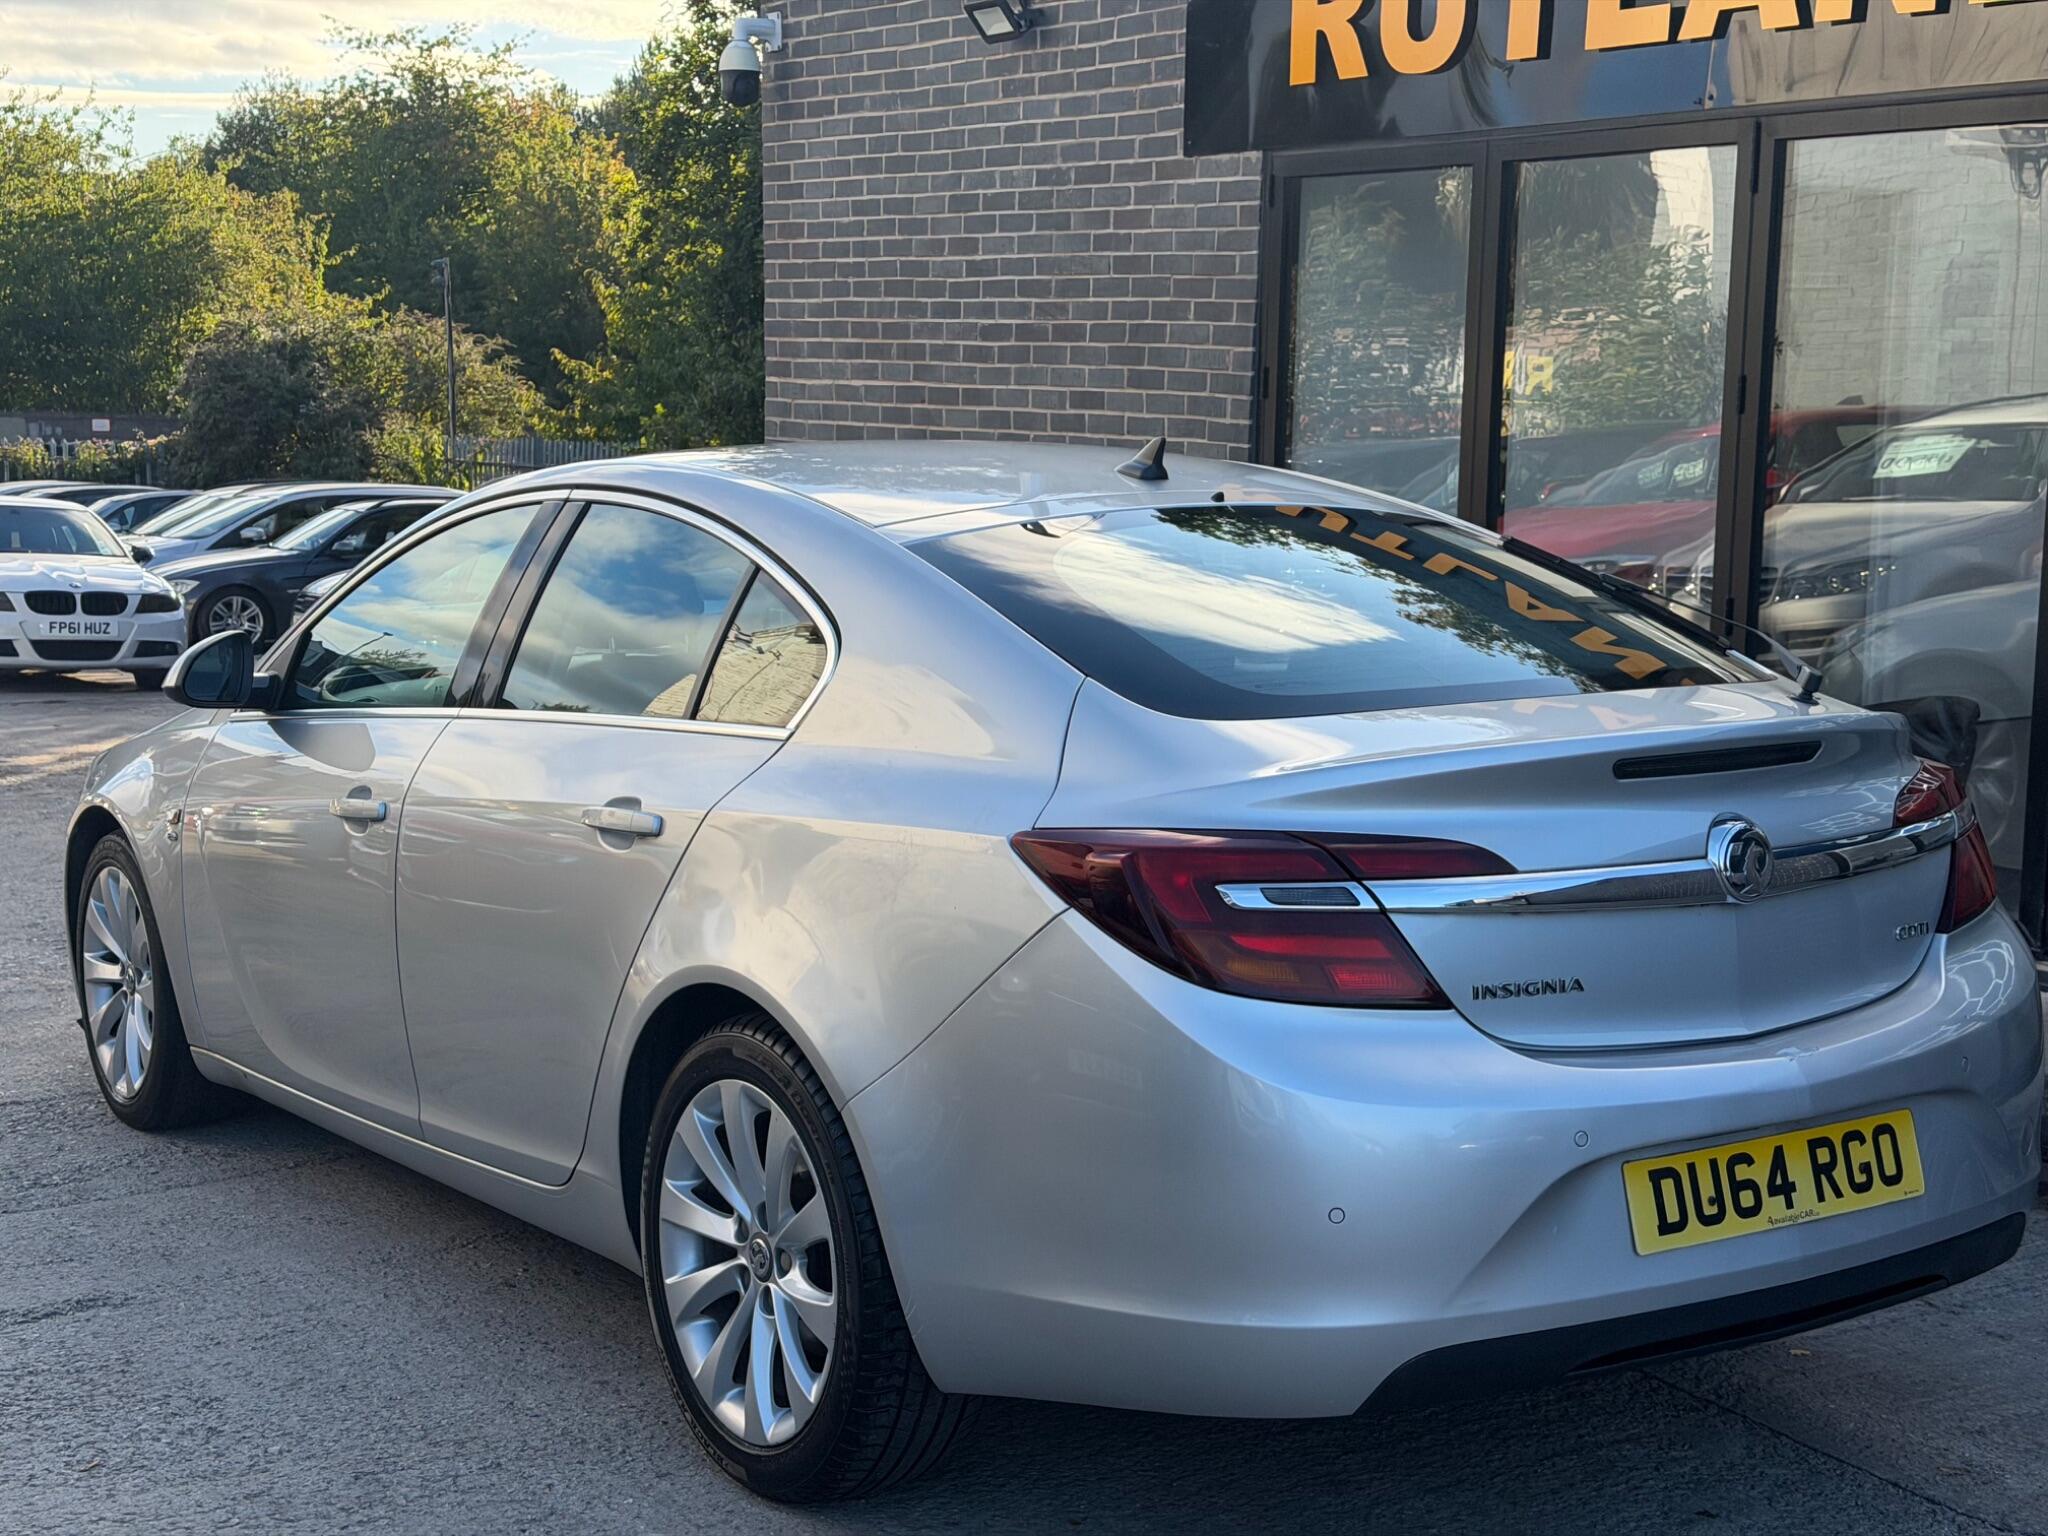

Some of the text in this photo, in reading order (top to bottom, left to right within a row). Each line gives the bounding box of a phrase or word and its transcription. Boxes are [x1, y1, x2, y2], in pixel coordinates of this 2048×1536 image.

[1289, 0, 2048, 86] RUTL
[48, 621, 111, 635] FP61 HUZ
[1471, 977, 1585, 1001] INSIGNIA
[1648, 1122, 1904, 1237] DU64 RGO
